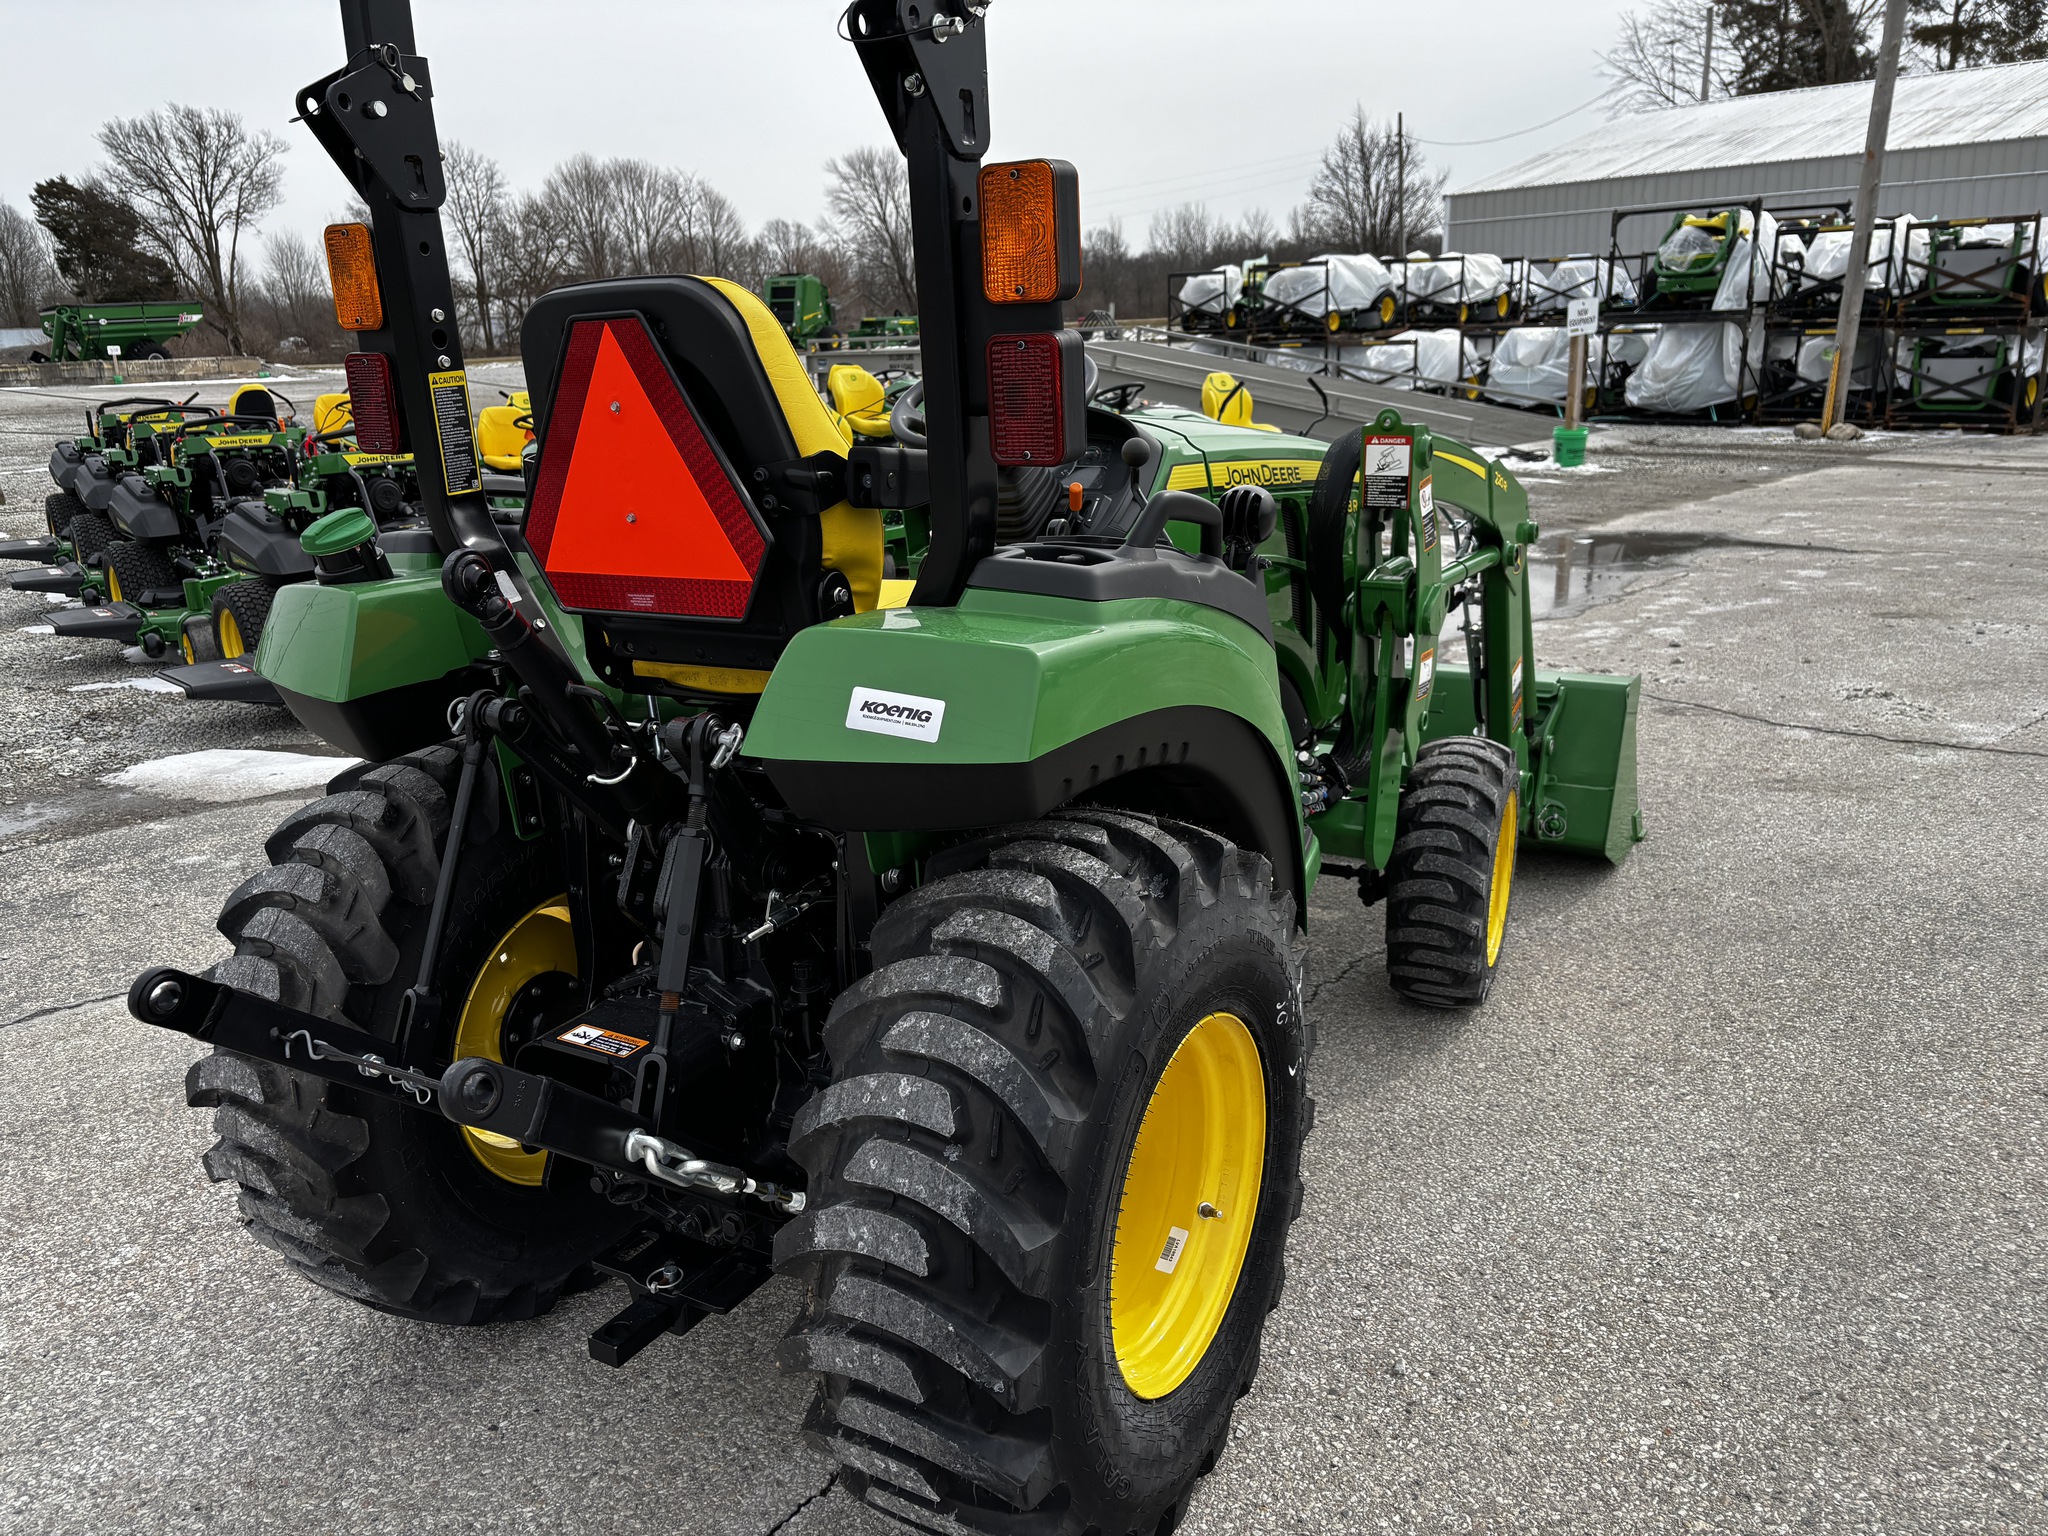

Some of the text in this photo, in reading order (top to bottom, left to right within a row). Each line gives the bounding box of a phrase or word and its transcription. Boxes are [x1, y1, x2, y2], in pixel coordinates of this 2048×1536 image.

[1577, 308, 1588, 316] NEW
[438, 375, 464, 384] CAUTION
[379, 454, 406, 462] DEERE
[1224, 464, 1302, 486] JOHN DEERE
